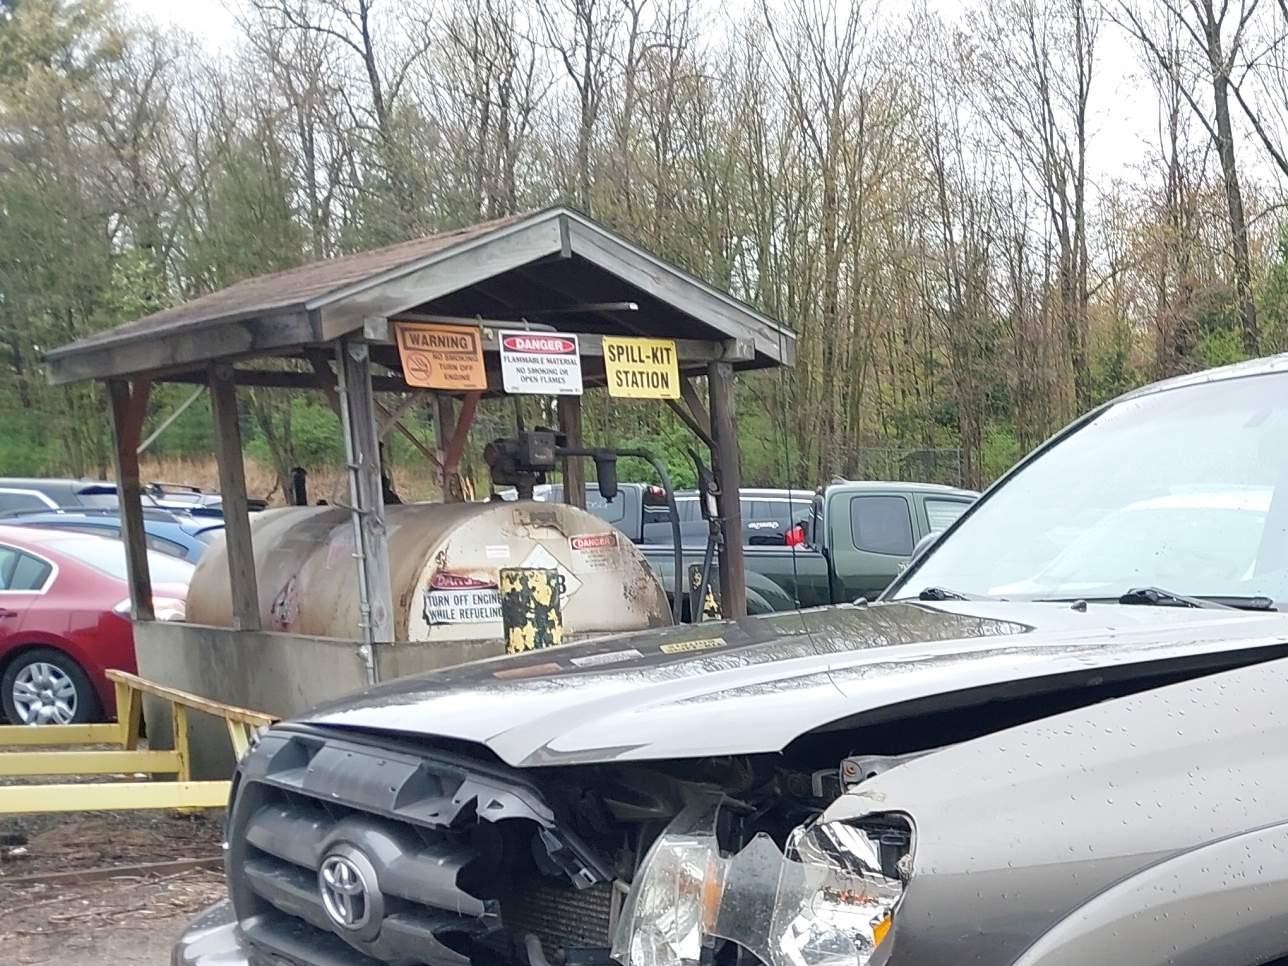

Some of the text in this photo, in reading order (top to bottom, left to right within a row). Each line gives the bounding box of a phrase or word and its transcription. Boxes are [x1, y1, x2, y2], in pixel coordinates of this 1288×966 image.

[408, 333, 469, 349] WARNING
[515, 338, 564, 351] DANGER
[504, 355, 545, 365] FLAMMABLE
[607, 344, 673, 365] SPILL-KIT
[516, 367, 526, 375] NO
[527, 367, 558, 376] SMOKING
[520, 376, 567, 385] OPEN FLAMES
[615, 369, 670, 390] STATION
[428, 594, 450, 607] TURN
[453, 594, 469, 606] OFF
[430, 608, 456, 620] WHILE
